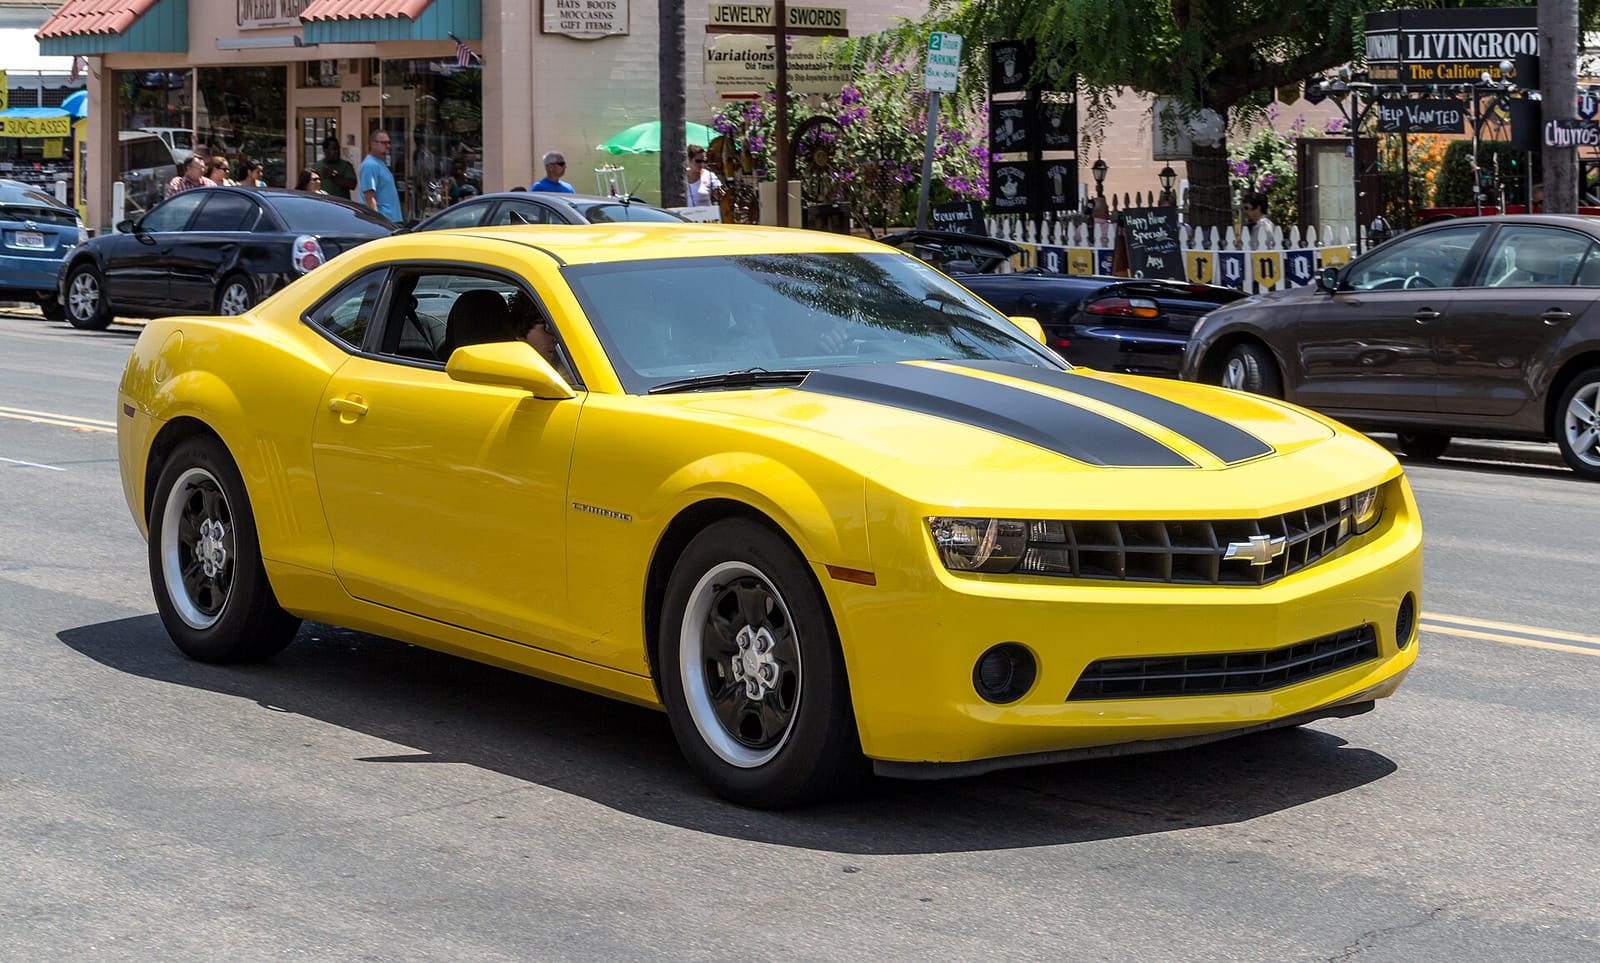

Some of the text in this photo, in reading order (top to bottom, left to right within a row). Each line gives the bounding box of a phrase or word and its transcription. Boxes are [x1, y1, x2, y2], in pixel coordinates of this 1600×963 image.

[556, 0, 617, 10] HATS BOOTS
[559, 10, 614, 20] MOCCASINS
[714, 6, 842, 26] JEWELRY SWORDS
[560, 21, 613, 30] GIFT ITEMS
[931, 36, 940, 48] 2
[1408, 32, 1540, 59] LIVINGROO
[707, 49, 775, 61] Variations
[930, 54, 957, 66] PARKING
[1409, 64, 1434, 79] The
[341, 91, 361, 103] 2525
[1377, 104, 1459, 125] HELP WANTED
[7, 120, 68, 135] SUNGLASSES
[1545, 120, 1598, 146] Churros
[1125, 211, 1167, 230] Happy Hour
[1132, 226, 1168, 244] Specials
